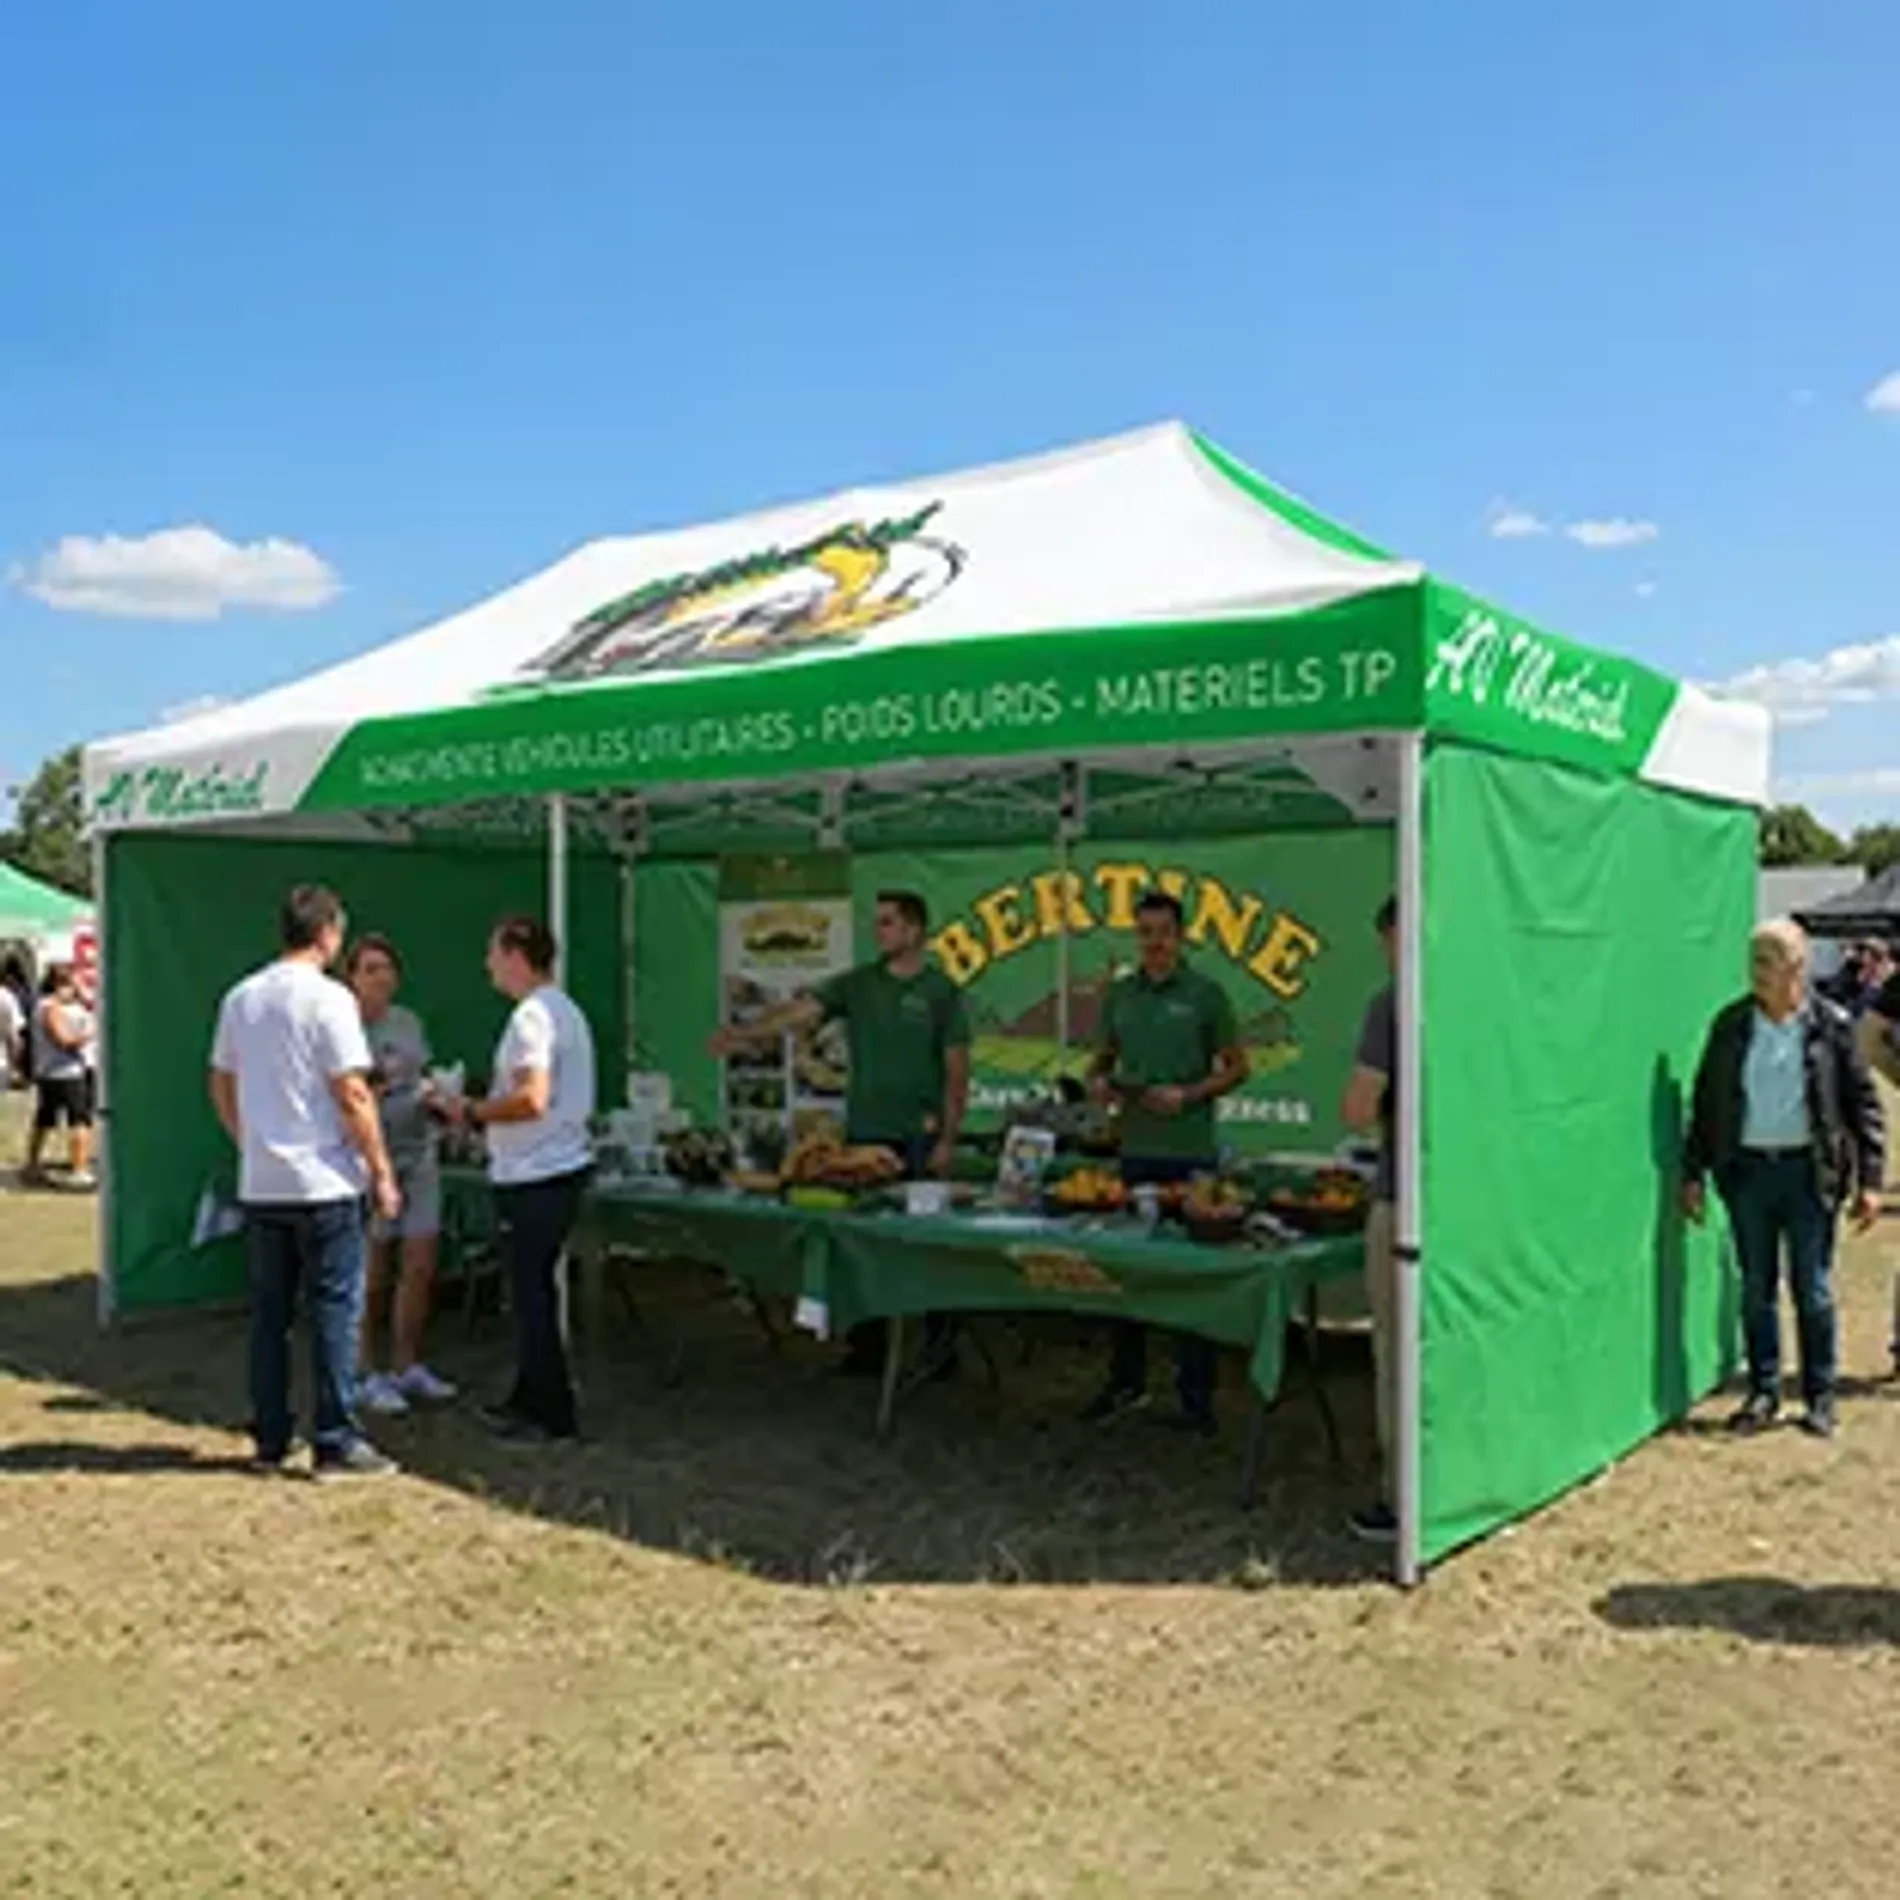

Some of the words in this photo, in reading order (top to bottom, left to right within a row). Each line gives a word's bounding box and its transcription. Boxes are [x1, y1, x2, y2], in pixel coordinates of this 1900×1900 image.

[821, 694, 917, 743] POIDS
[923, 678, 1062, 733] LOURDS
[1095, 656, 1327, 717] MATERIELS
[1339, 648, 1397, 700] TP
